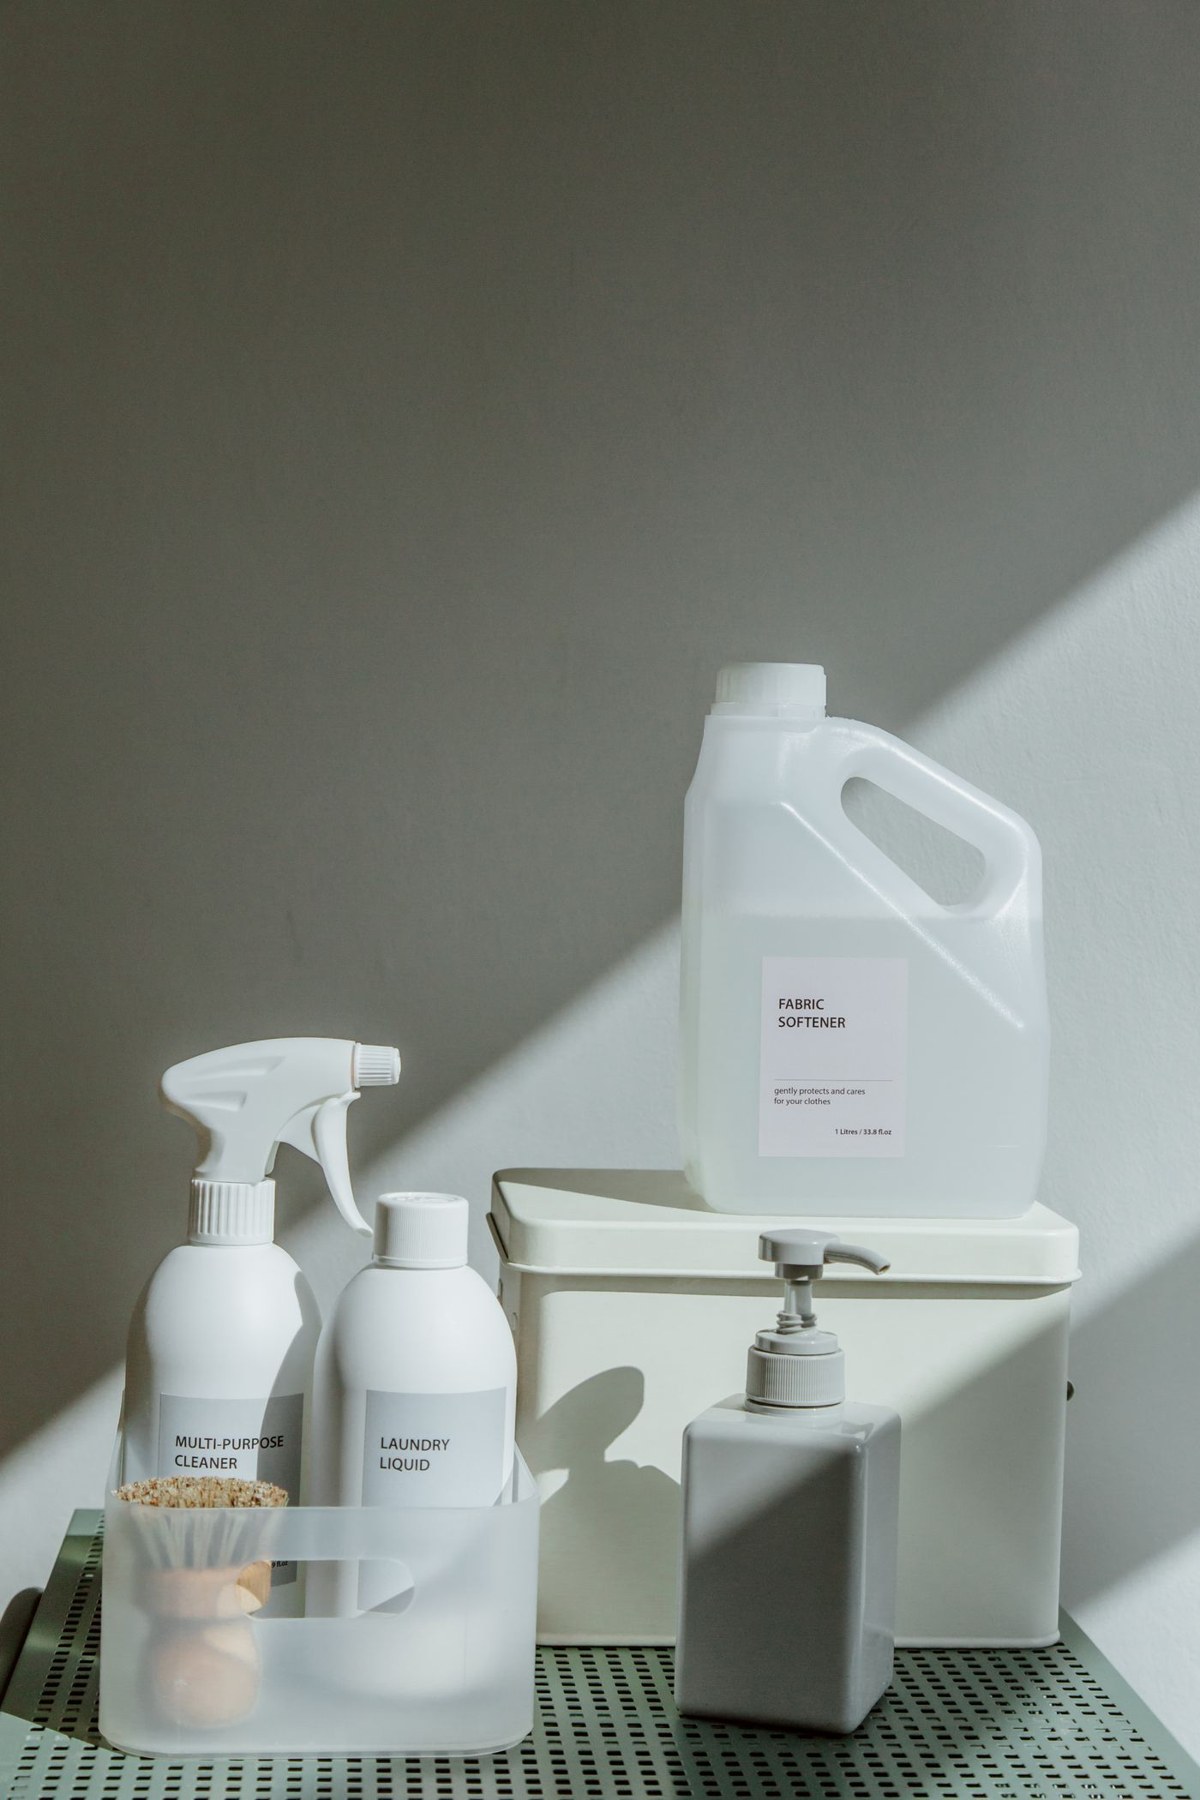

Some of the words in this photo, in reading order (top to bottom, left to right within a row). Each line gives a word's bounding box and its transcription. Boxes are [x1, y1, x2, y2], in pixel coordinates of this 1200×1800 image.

[778, 998, 824, 1010] FABRIC
[778, 1016, 846, 1028] SOFTENER
[774, 1087, 797, 1096] gently
[799, 1087, 830, 1096] protects
[831, 1087, 844, 1095] and
[774, 1097, 784, 1105] for
[786, 1099, 803, 1107] your
[804, 1097, 831, 1106] clothes
[840, 1128, 858, 1136] Litres
[863, 1128, 877, 1136] 33.8
[878, 1128, 892, 1136] fl.oz
[175, 1435, 284, 1451] MULTI-PURPOSE
[380, 1436, 450, 1451] LAUNDRY
[174, 1454, 238, 1470] CLEANER
[380, 1457, 431, 1473] LIQUID
